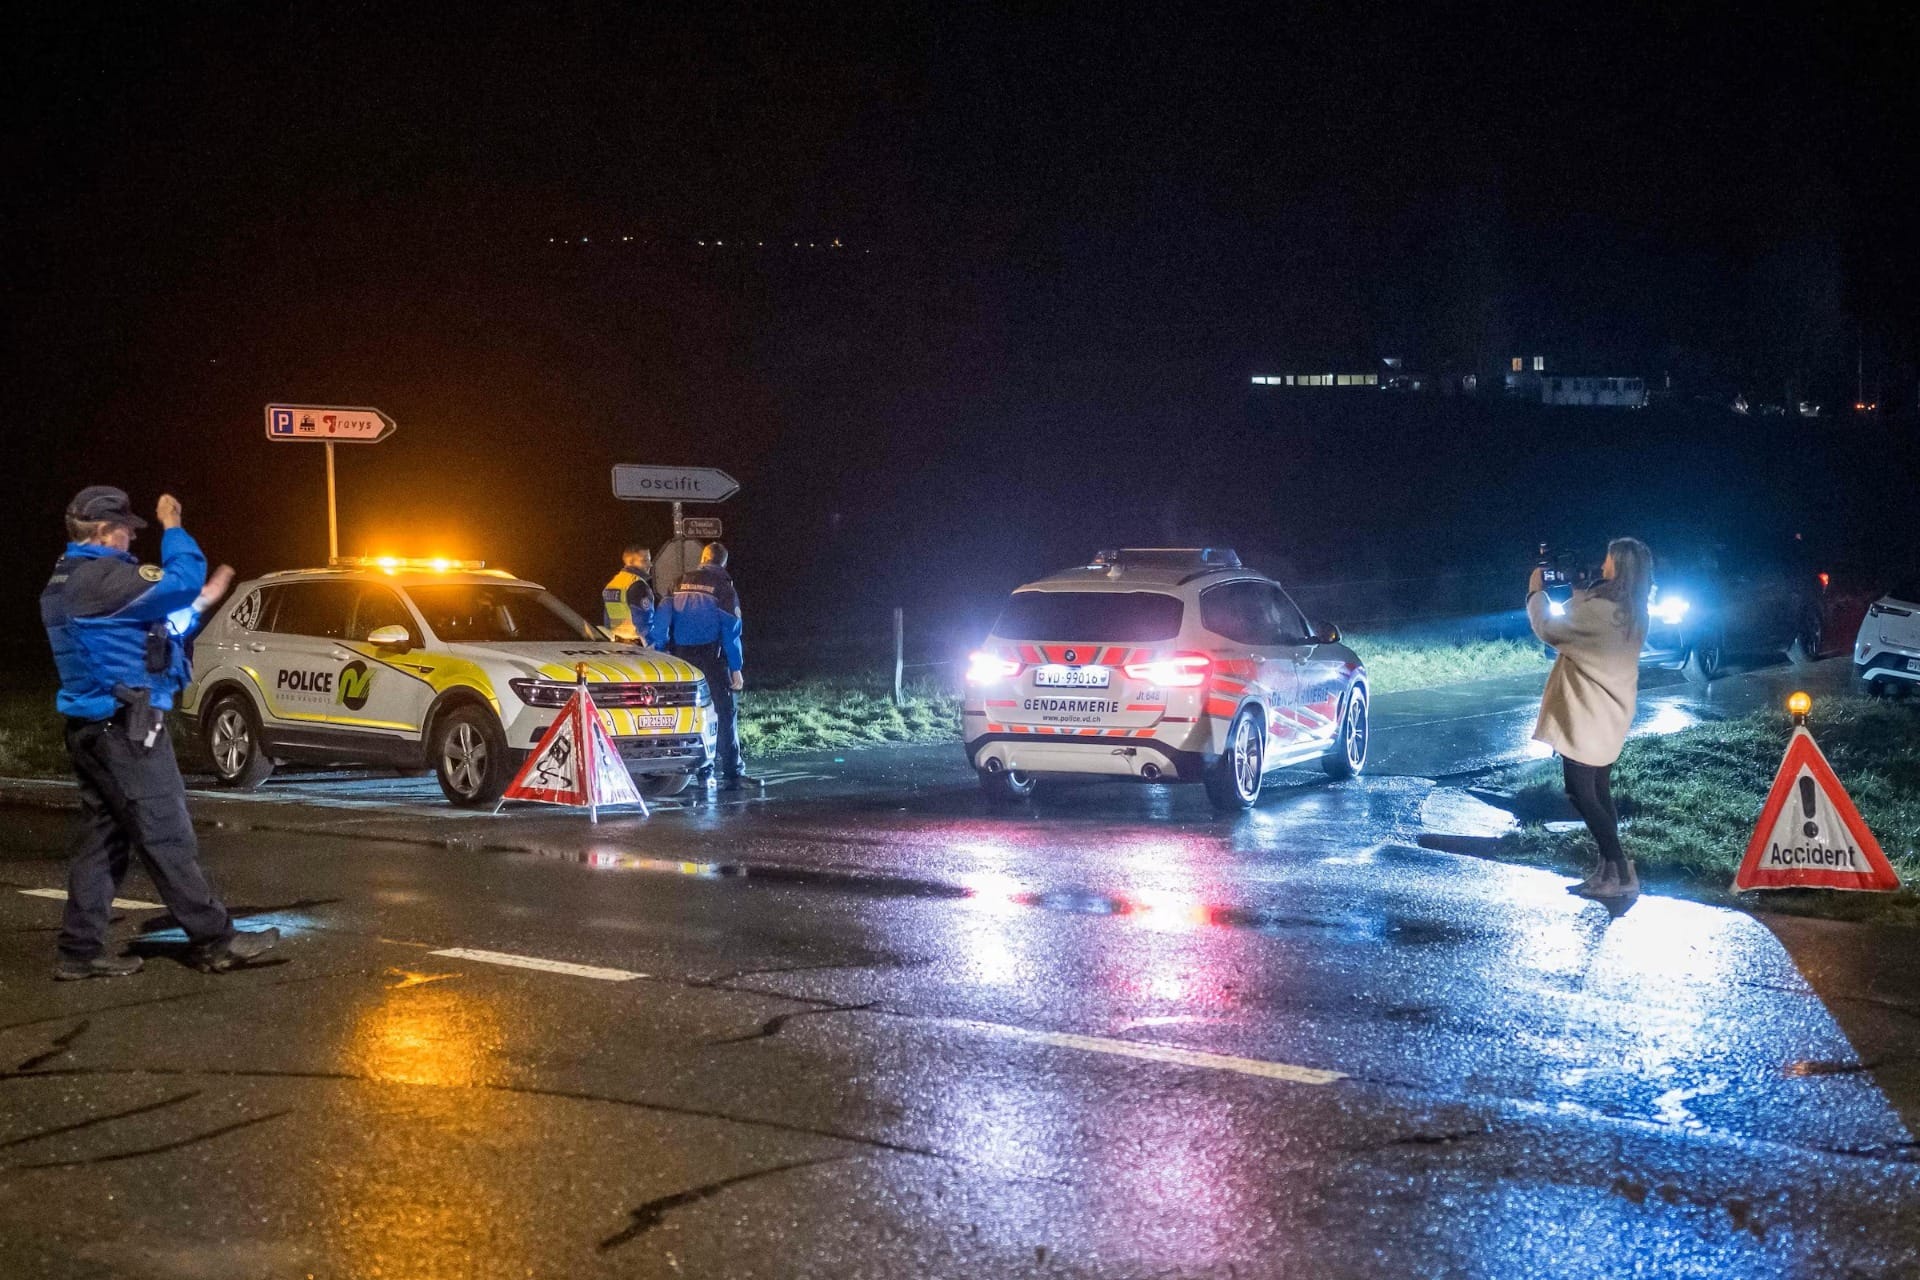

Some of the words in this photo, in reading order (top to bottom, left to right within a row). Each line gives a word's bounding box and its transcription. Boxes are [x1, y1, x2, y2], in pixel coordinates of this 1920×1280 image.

[278, 414, 289, 431] P
[277, 669, 333, 692] POLICE
[1023, 699, 1119, 713] GENDARMERIE
[1043, 714, 1101, 723] www.police.vd.ch
[1771, 842, 1856, 867] Accident
